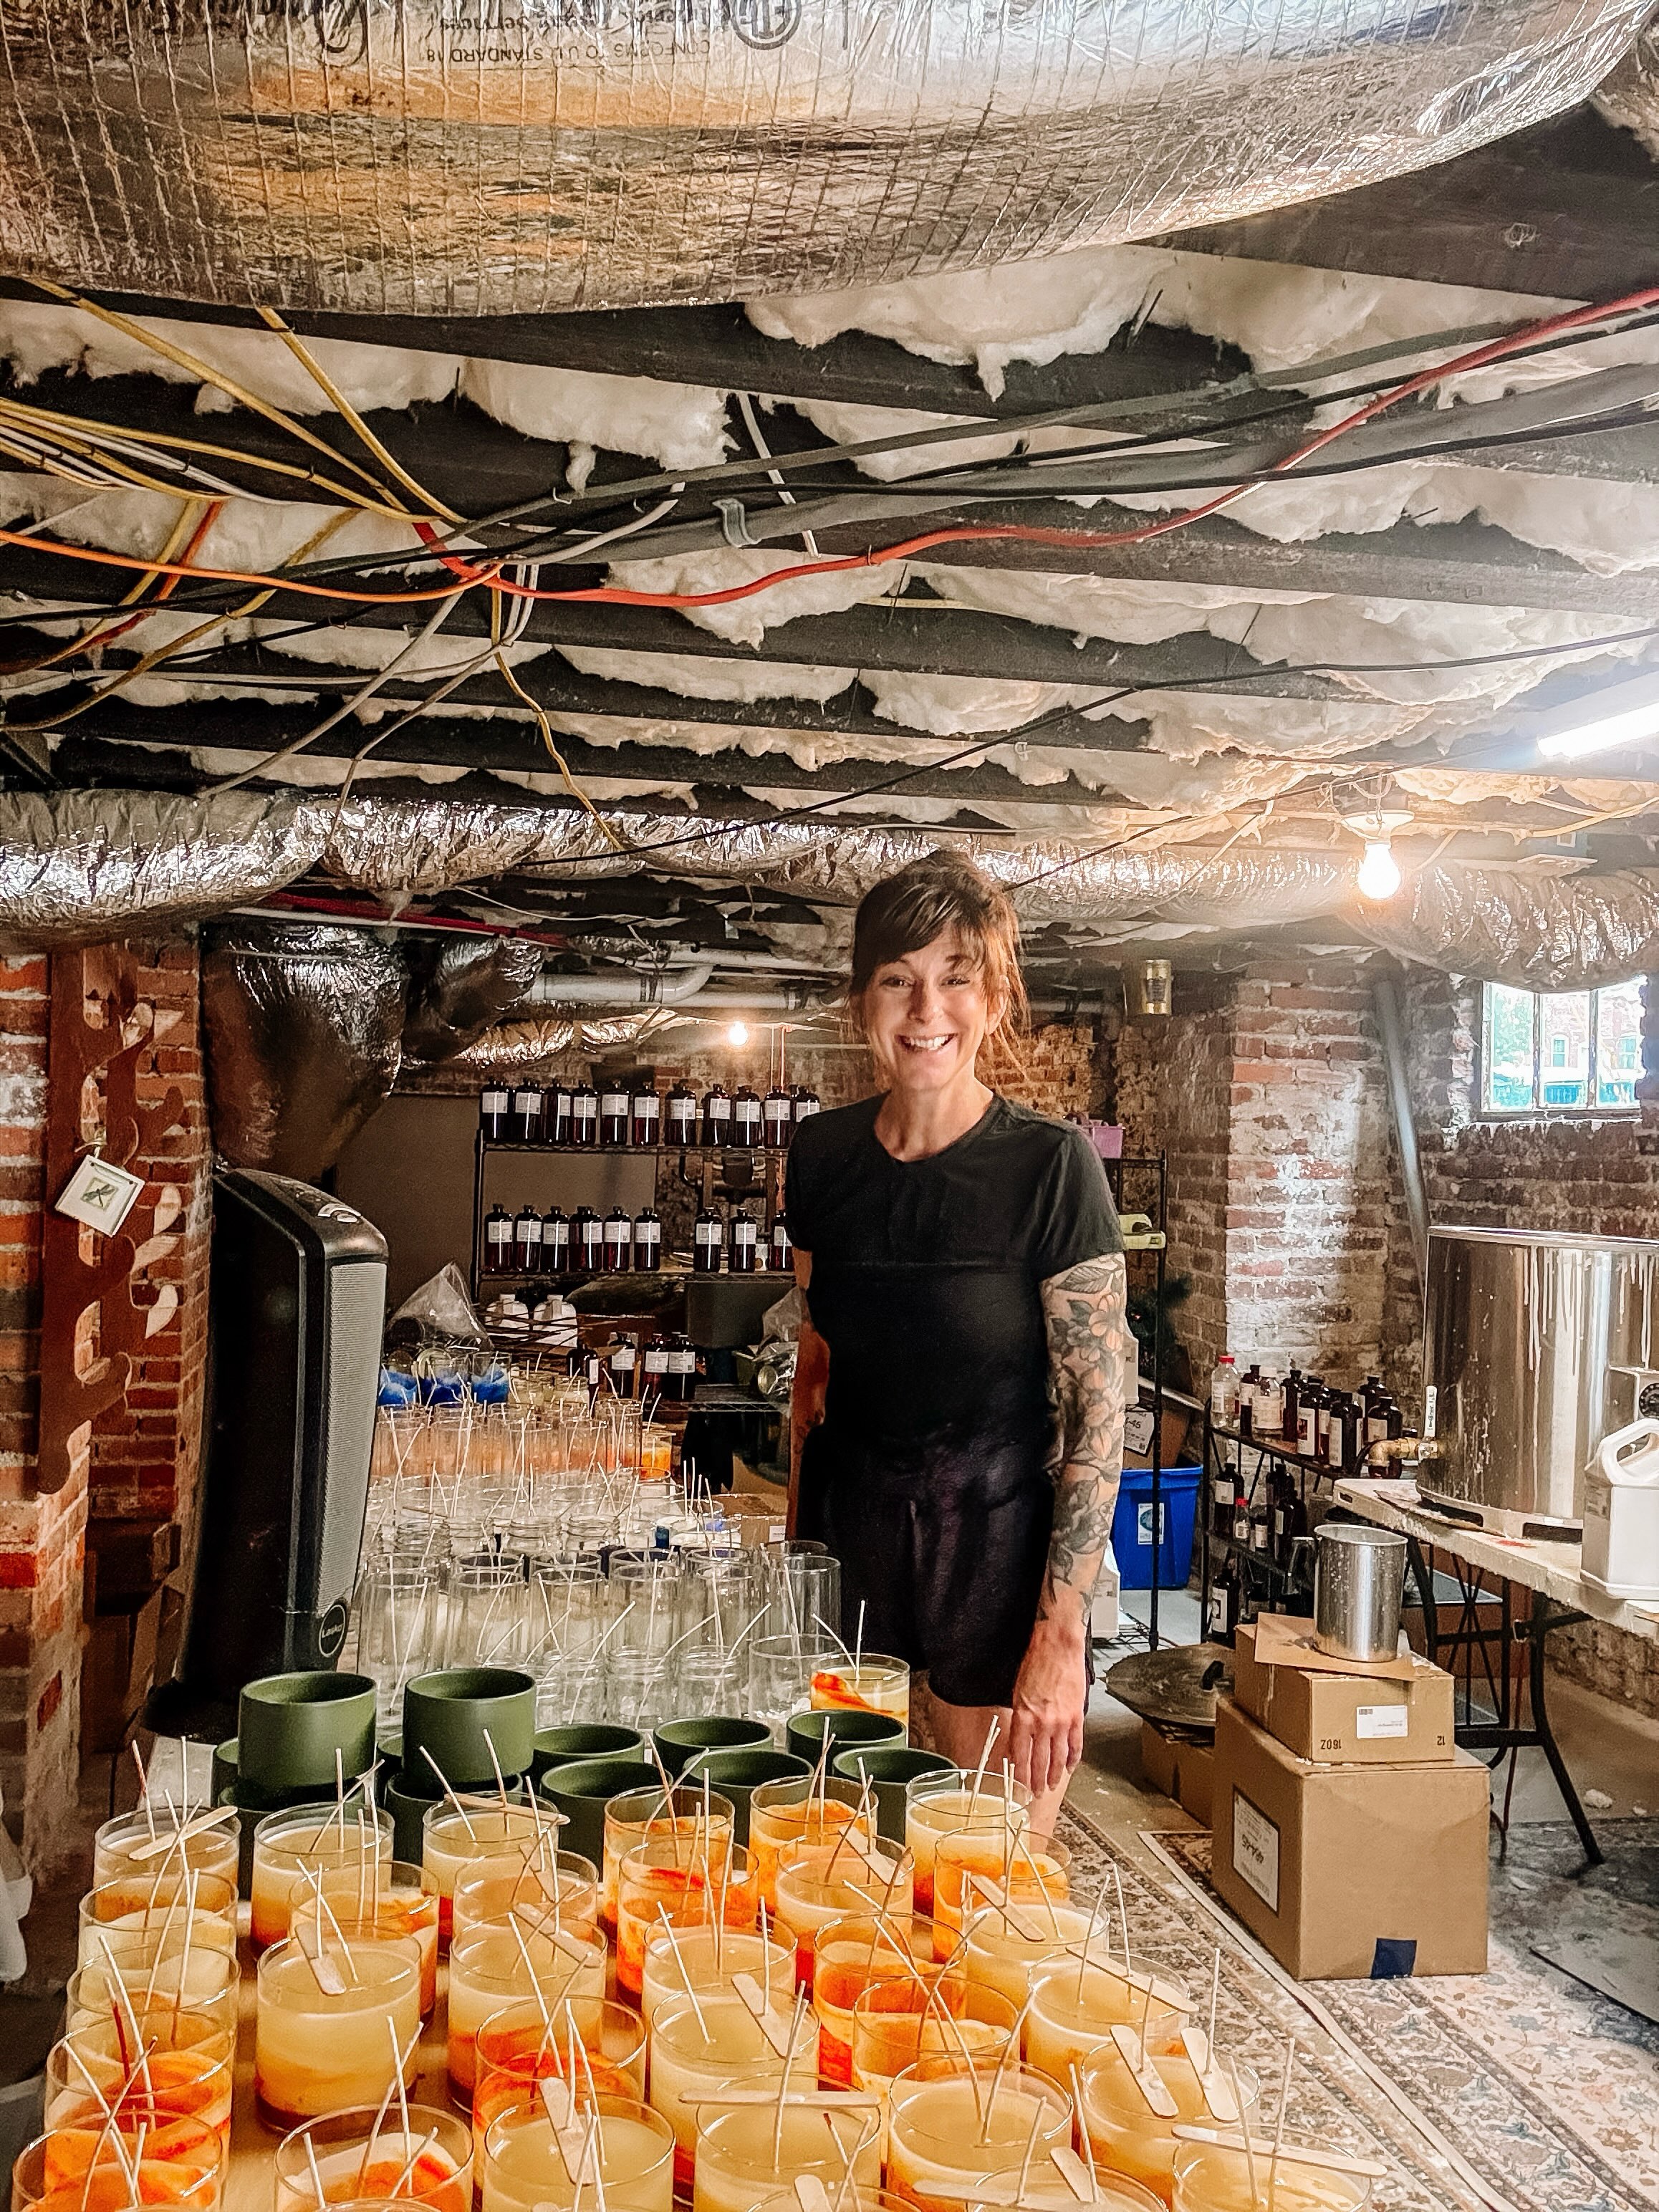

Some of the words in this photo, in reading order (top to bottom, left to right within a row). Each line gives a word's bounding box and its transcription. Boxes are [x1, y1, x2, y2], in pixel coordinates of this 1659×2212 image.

[451, 47, 544, 62] STANDARD
[322, 1624, 342, 1638] Lasko
[1436, 1735, 1446, 1746] 12
